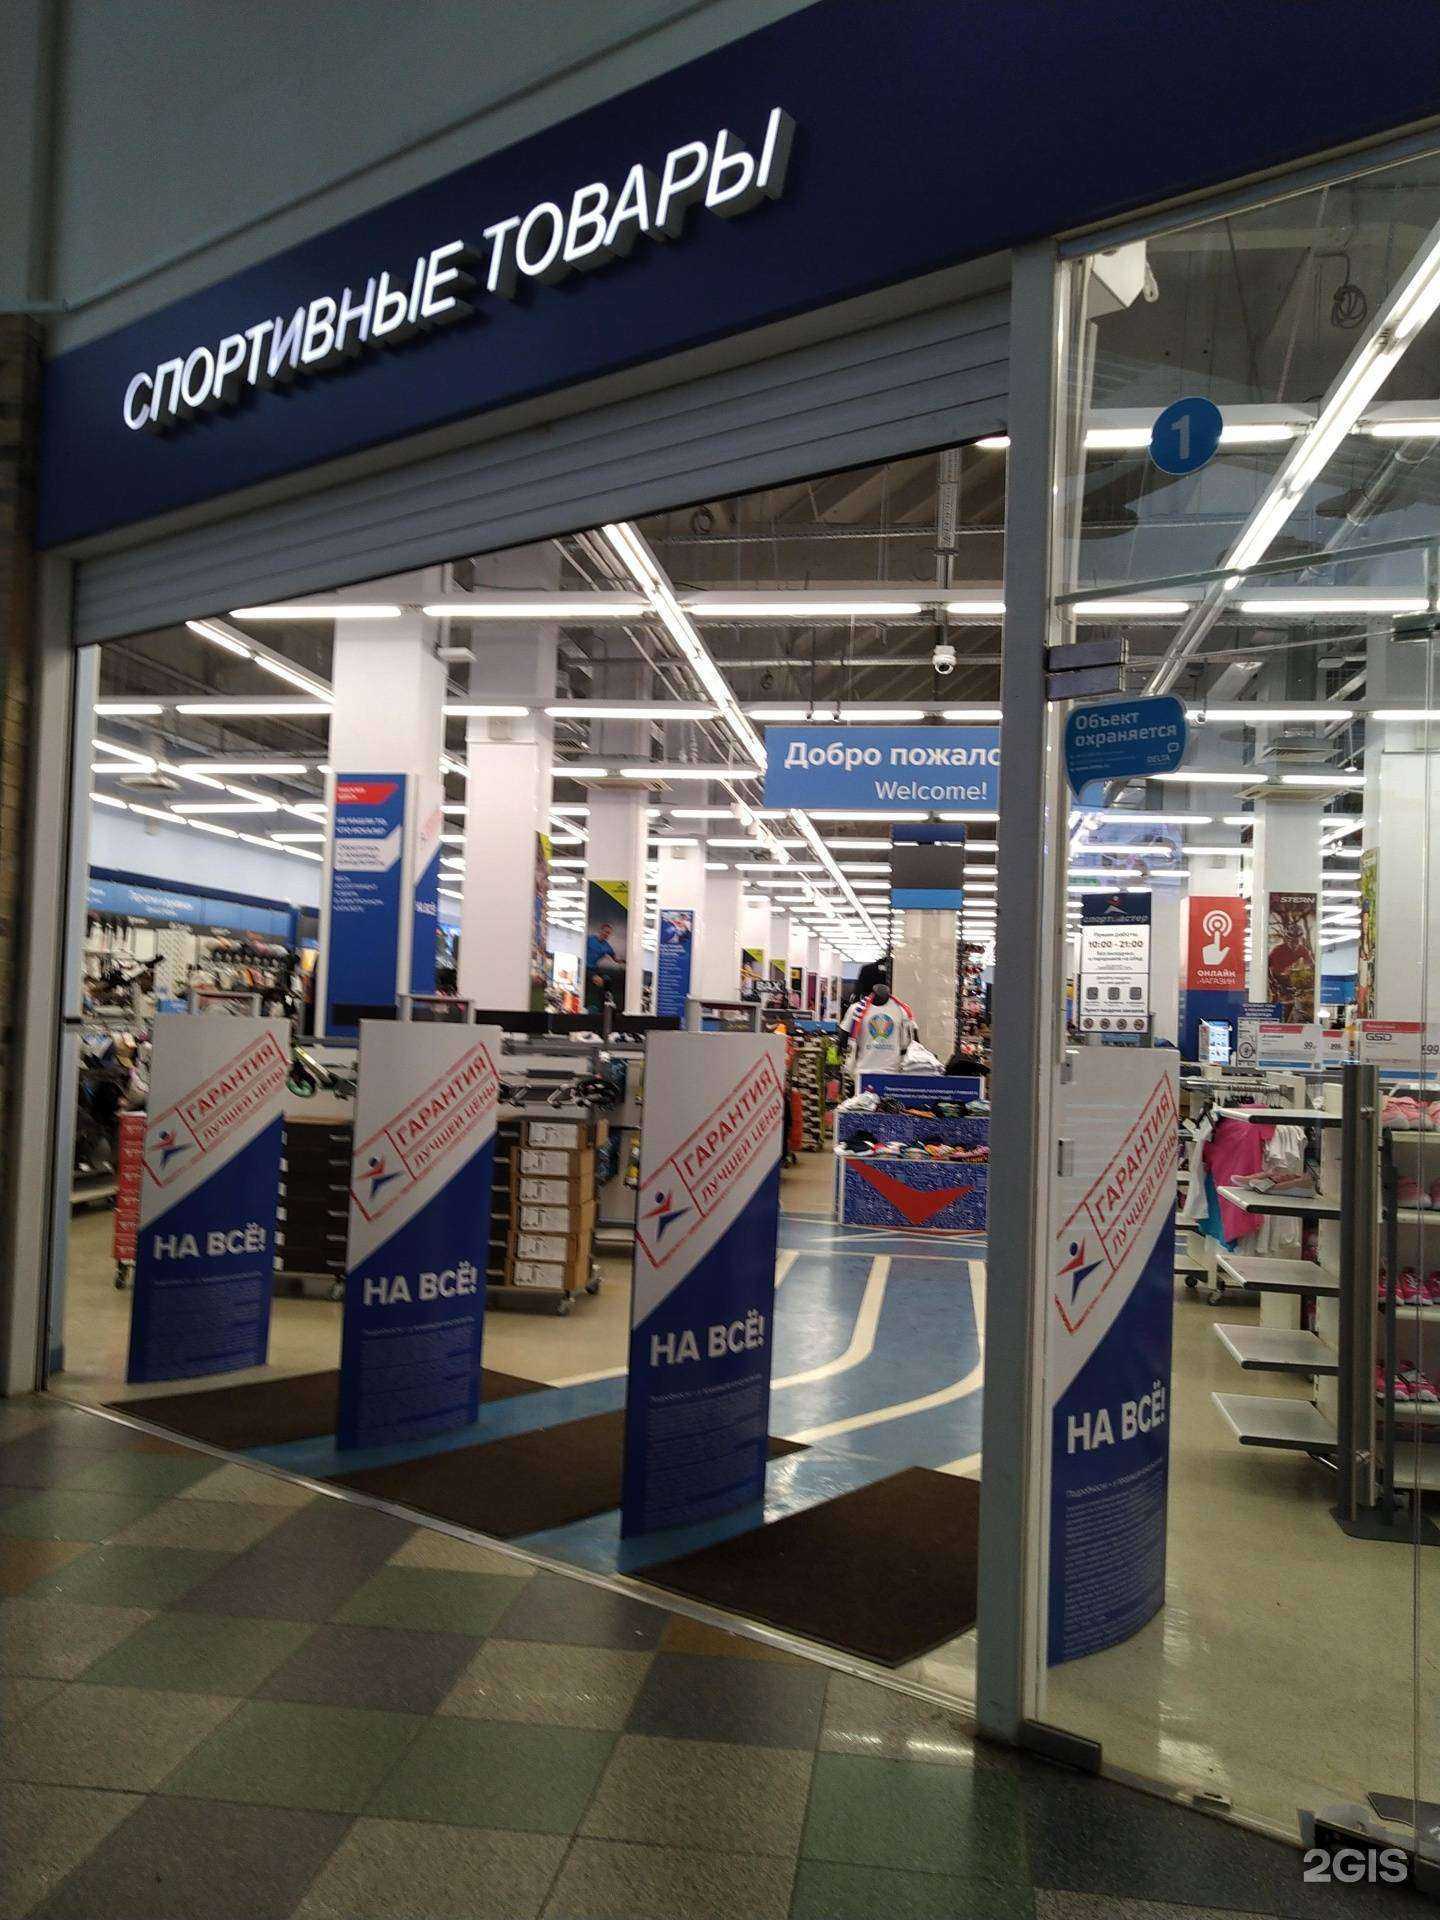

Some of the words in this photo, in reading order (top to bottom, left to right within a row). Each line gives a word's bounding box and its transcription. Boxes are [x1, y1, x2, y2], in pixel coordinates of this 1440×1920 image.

[123, 241, 466, 430] СПОРТИВНЫЕ
[482, 107, 784, 292] ТОВАРЫ
[1171, 415, 1191, 459] 1
[1075, 711, 1140, 730] Объект
[1075, 724, 1177, 748] охраняется
[784, 742, 882, 771] Добро
[875, 781, 988, 800] Welcome!
[1197, 969, 1236, 977] ОНЛАЙН
[186, 1045, 274, 1121] ГАРАНТИЯ
[396, 1055, 487, 1146] ГАРАНТИЯ
[414, 1114, 464, 1169] ЛУЧШЕЙ
[464, 1083, 496, 1127] ЦЕНЫ
[683, 1069, 773, 1177] ГАРАНТИЯ
[701, 1141, 751, 1203] ЛУЧШЕЙ
[750, 1099, 782, 1148] ЦЕНЫ
[1094, 1093, 1171, 1223] ГАРАНТИЯ
[1111, 1178, 1154, 1255] ЛУЧШЕЙ
[1153, 1130, 1177, 1187] ЦЕНЫ
[153, 1233, 200, 1260] НА
[206, 1222, 266, 1257] ВСЁ!
[362, 1275, 412, 1306] НА
[418, 1260, 478, 1301] ВСЁ!
[650, 1330, 701, 1368] НА
[707, 1308, 766, 1359] ВСЁ!
[1066, 1407, 1115, 1454] НА
[1121, 1378, 1166, 1438] ВСЁ!
